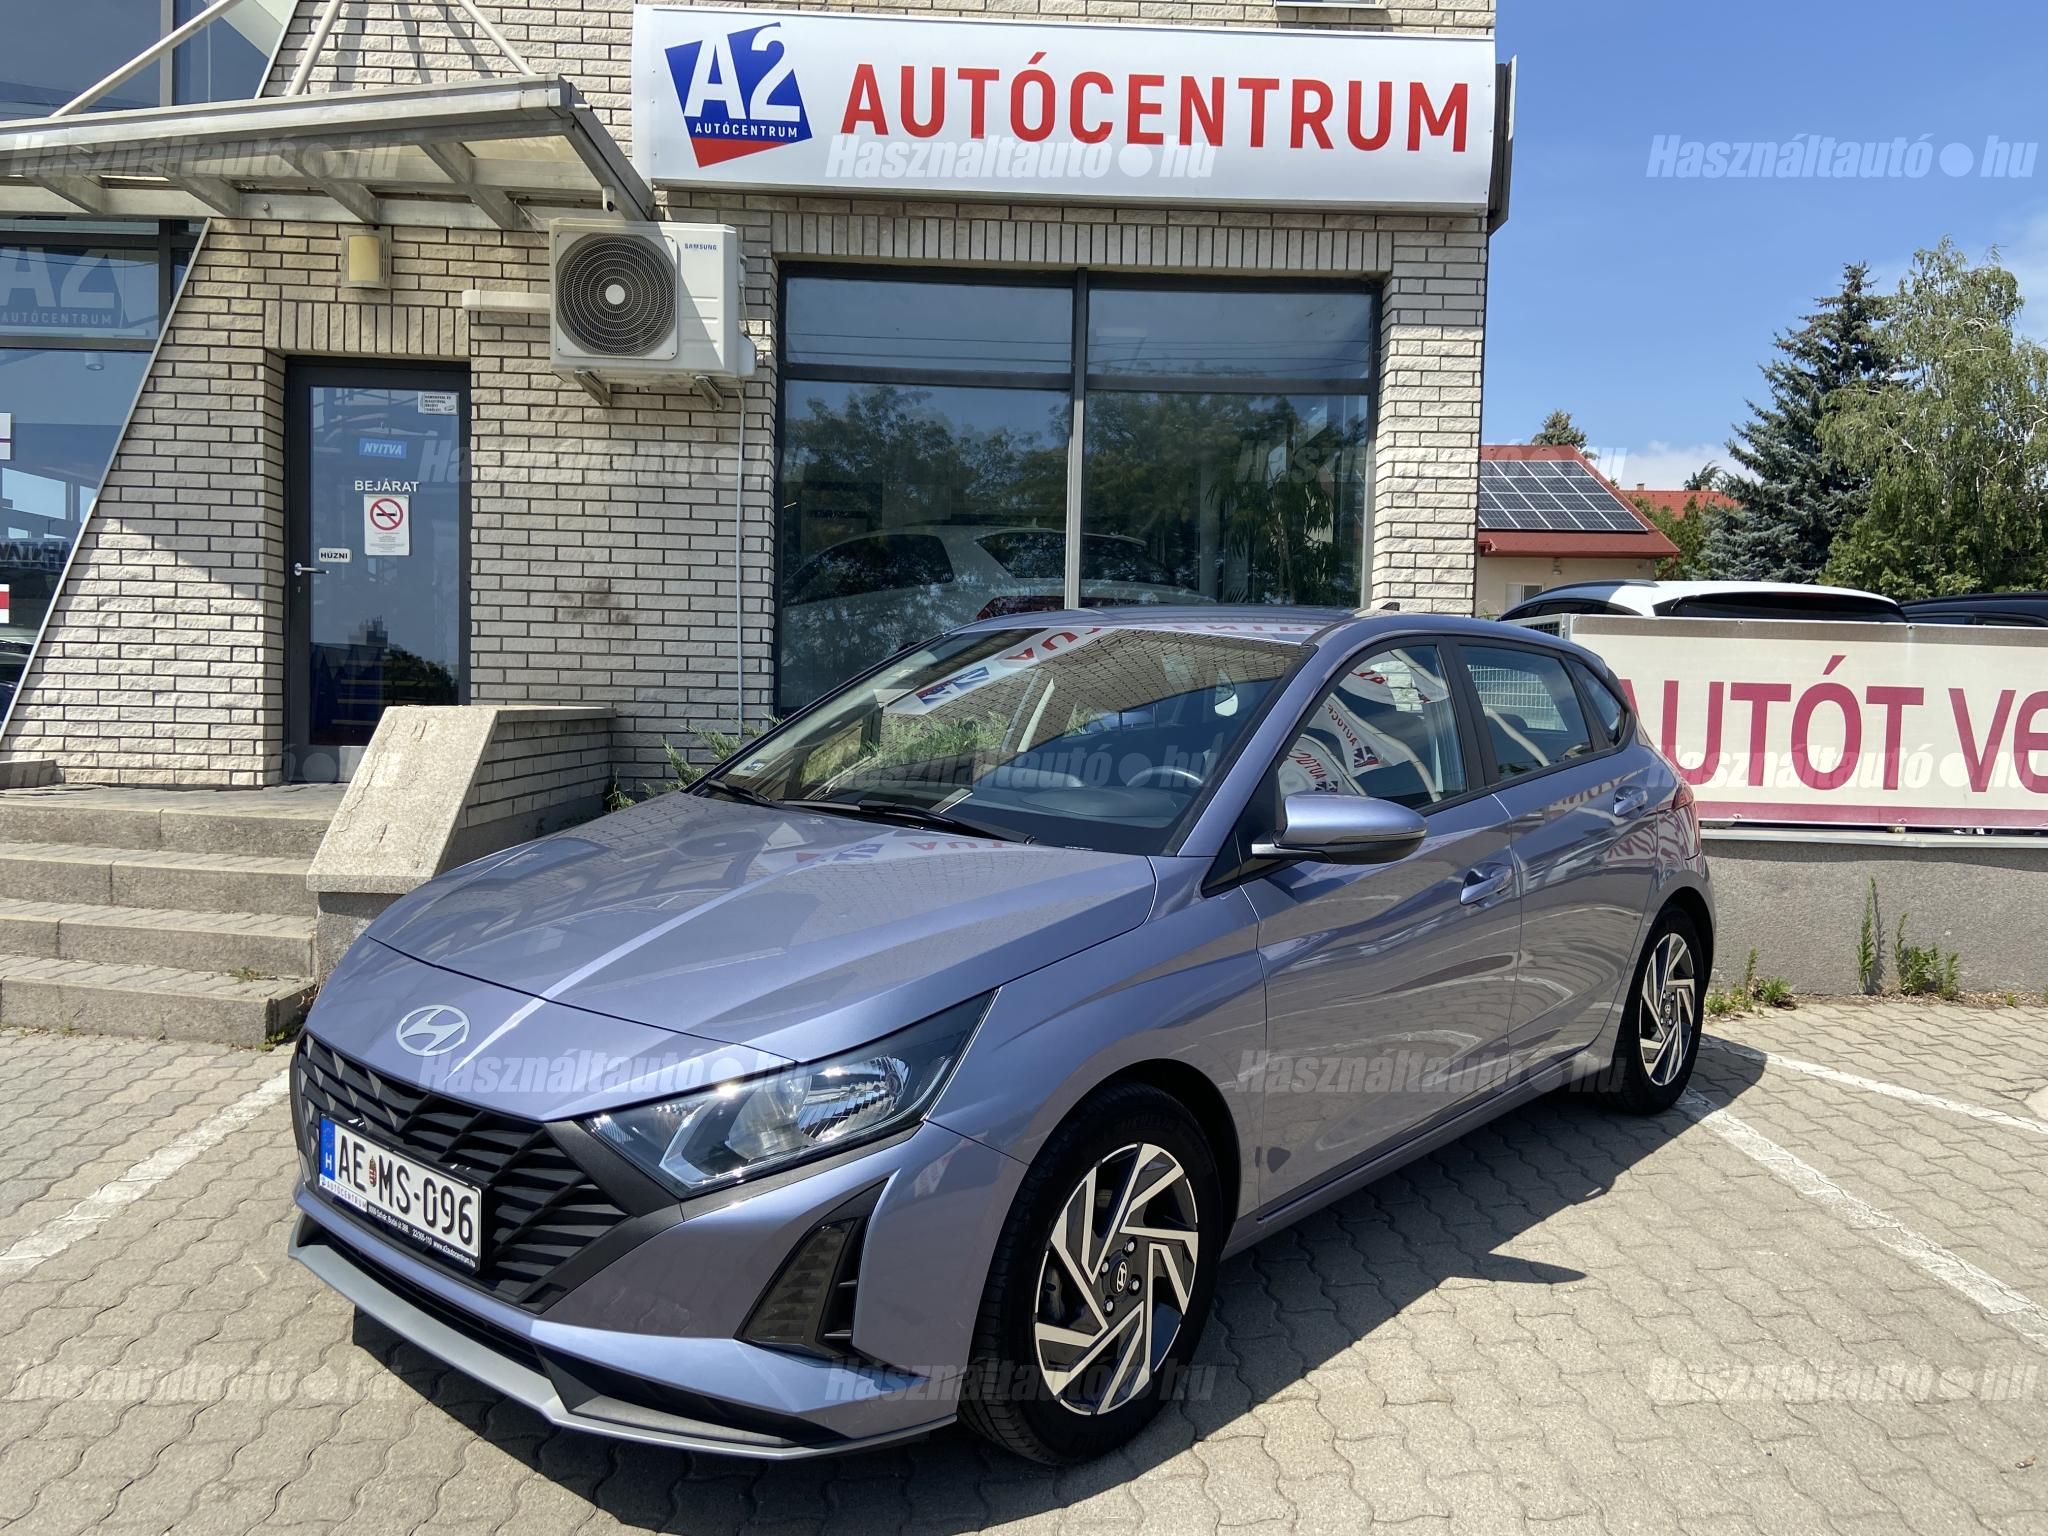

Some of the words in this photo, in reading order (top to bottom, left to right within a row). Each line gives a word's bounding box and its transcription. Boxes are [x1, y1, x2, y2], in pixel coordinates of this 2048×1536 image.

[684, 27, 800, 122] A2
[841, 51, 1468, 153] AUTÓCENTRUM
[695, 121, 798, 138] AUTÓCENTRUM
[363, 442, 403, 455] NYITVA
[354, 478, 420, 492] BEJÁRAT
[1618, 655, 1925, 792] UTÓT
[325, 1153, 333, 1171] H
[379, 1154, 473, 1245] MS-096
